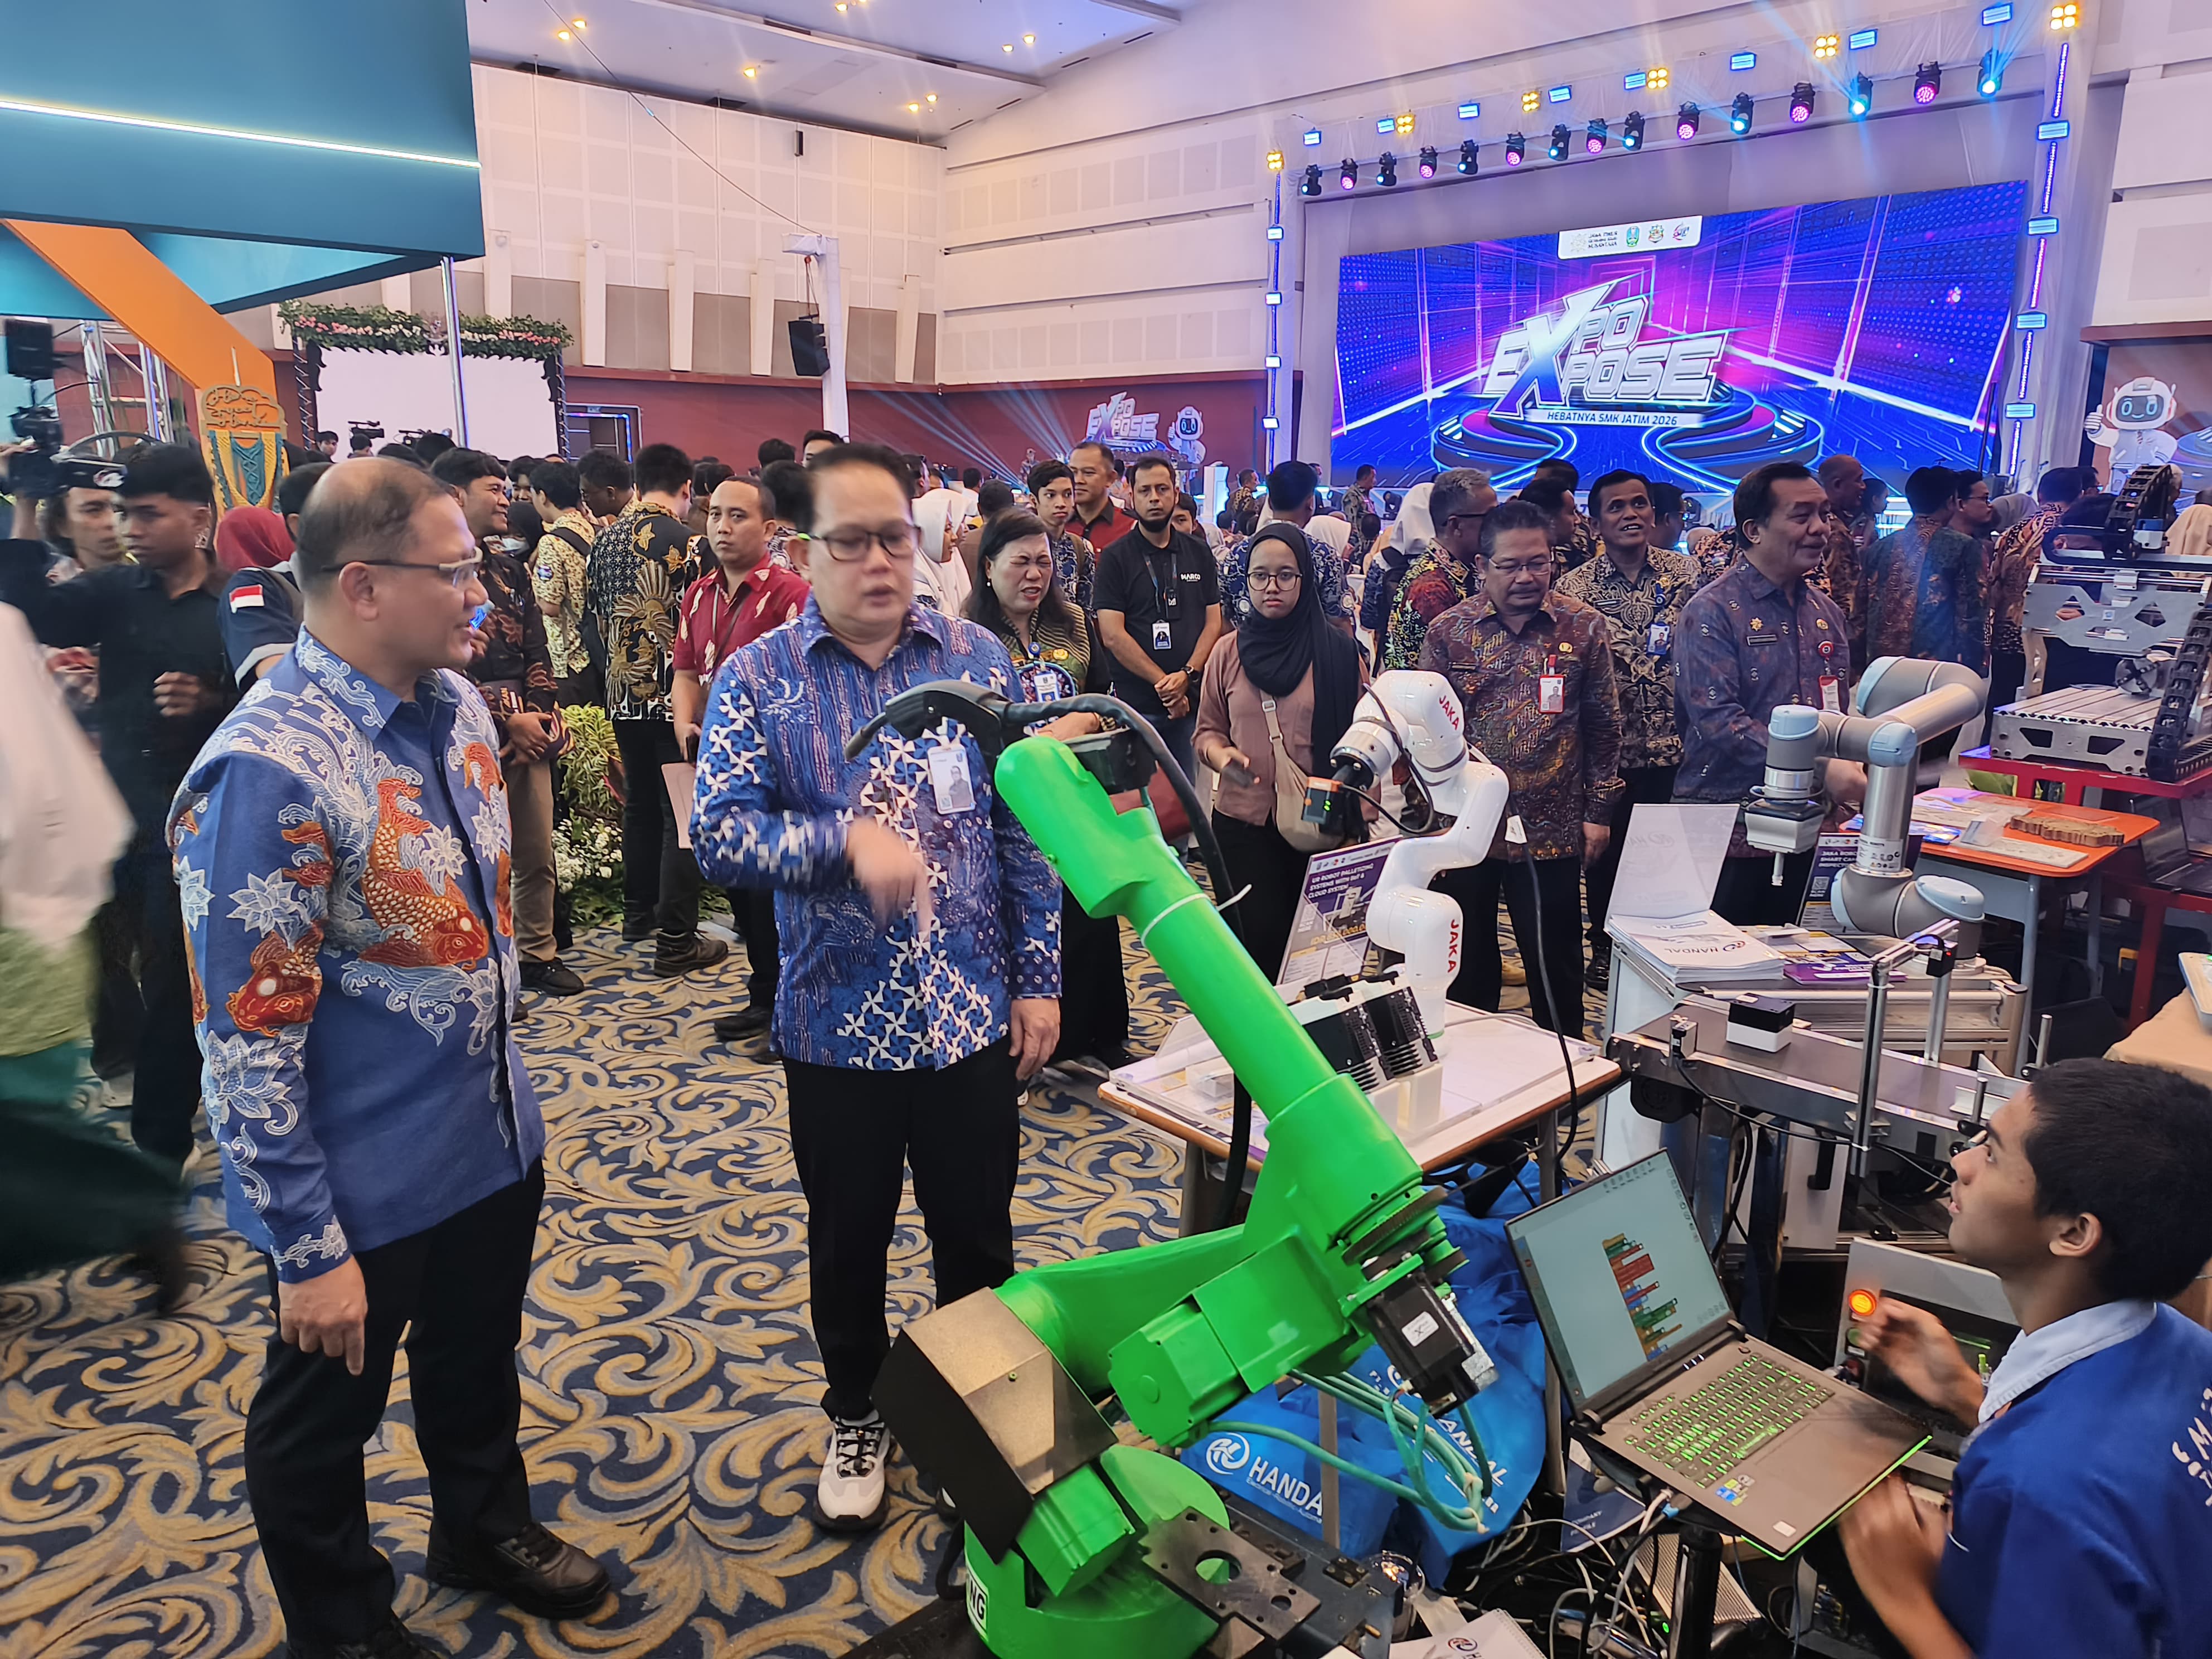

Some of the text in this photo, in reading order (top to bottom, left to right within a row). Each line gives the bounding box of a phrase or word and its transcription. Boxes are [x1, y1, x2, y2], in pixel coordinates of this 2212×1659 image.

[1548, 411, 1677, 425] HEBATNYA SMK JATIM 2026
[1439, 695, 1459, 730] JAKA
[1321, 871, 1341, 881] ROBOT
[1447, 919, 1459, 973] JAKA
[1249, 1456, 1323, 1516] HANDA
